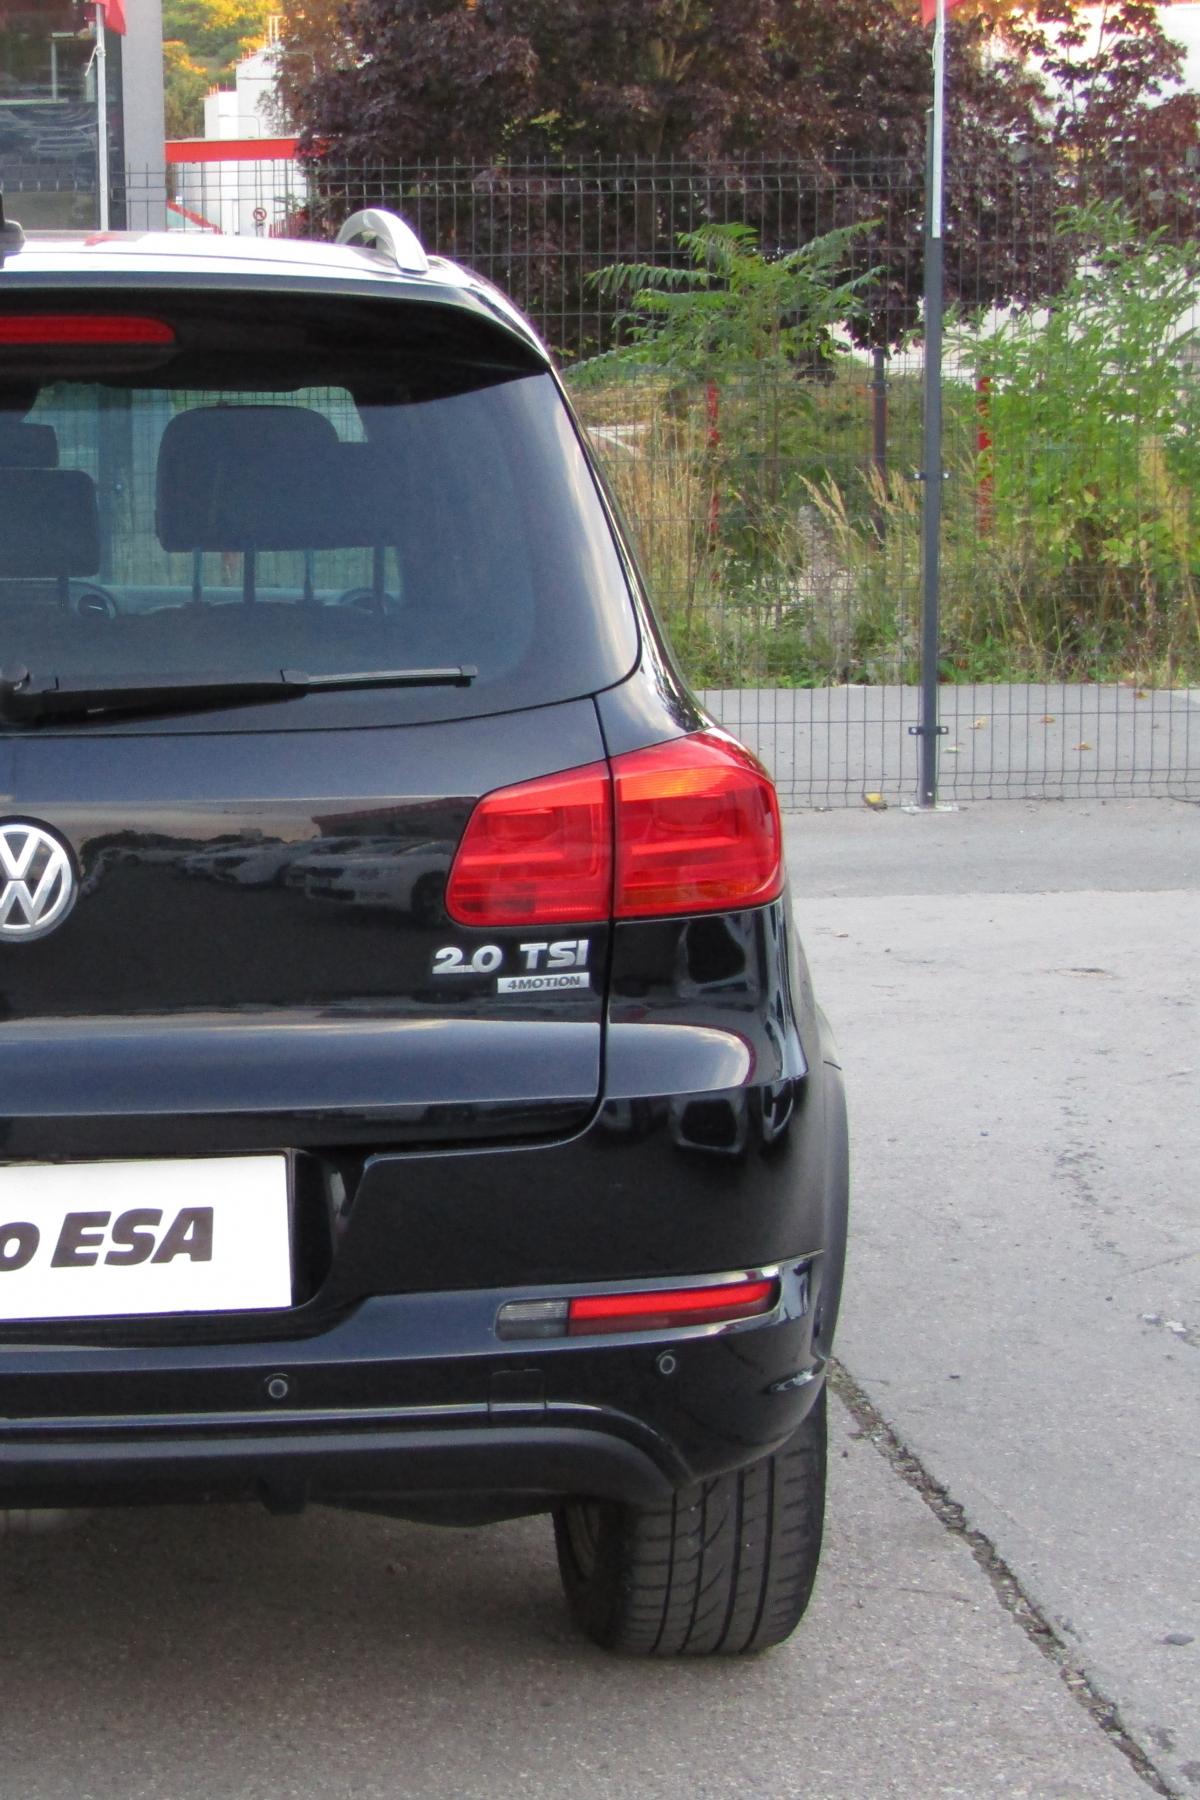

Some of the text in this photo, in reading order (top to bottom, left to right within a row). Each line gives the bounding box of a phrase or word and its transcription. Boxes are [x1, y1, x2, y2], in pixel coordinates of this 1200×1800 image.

[432, 939, 589, 974] 2.0 TSI
[506, 975, 581, 991] 4MOTION
[50, 1206, 214, 1268] ESA
